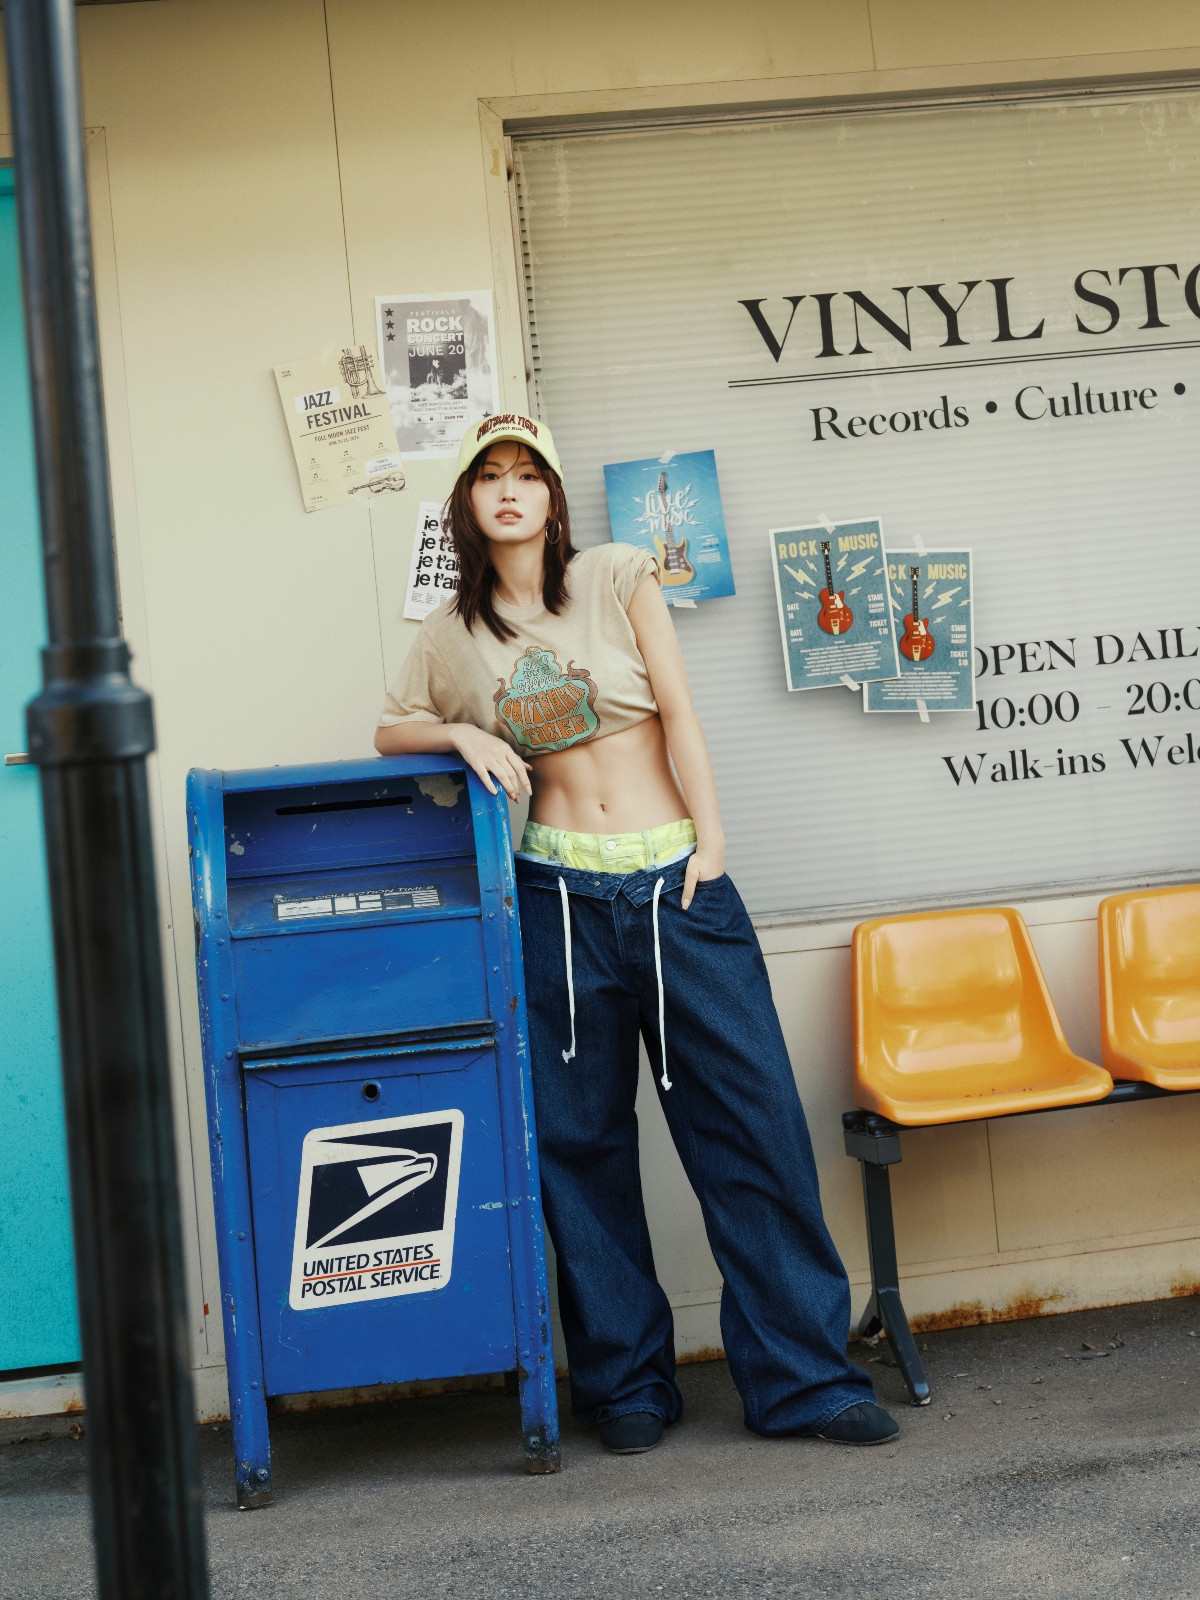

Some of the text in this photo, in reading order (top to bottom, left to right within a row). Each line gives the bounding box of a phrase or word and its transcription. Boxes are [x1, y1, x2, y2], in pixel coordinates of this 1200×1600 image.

[410, 309, 456, 317] FESTIVALS
[737, 262, 1200, 363] VINYL ST
[406, 315, 464, 333] ROCK
[407, 332, 464, 344] CONCERT
[409, 344, 464, 358] JUNE 20
[303, 390, 333, 411] JAZZ
[306, 403, 371, 429] FESTIVAL
[809, 382, 1158, 441] Records Culture
[314, 424, 370, 443] FULL MOON JAZZ FEST
[518, 415, 538, 439] TIGER
[419, 532, 436, 551] je
[778, 533, 879, 559] ROCK MUSIC
[416, 551, 433, 569] je
[413, 570, 430, 588] je
[928, 563, 967, 580] MUSIC
[787, 603, 799, 611] DATE
[867, 593, 883, 601] STAGE
[869, 619, 887, 627] TICKET
[950, 650, 967, 658] TICKET
[1093, 626, 1200, 666] DAIL
[502, 682, 586, 725] ONITSUKA
[975, 690, 1080, 731] 10:00
[521, 714, 589, 745] TIGER
[941, 732, 1200, 786] Walk-ins Wel
[303, 1243, 434, 1277] UNITED STATES
[301, 1263, 440, 1298] POSTAL SERVICE
